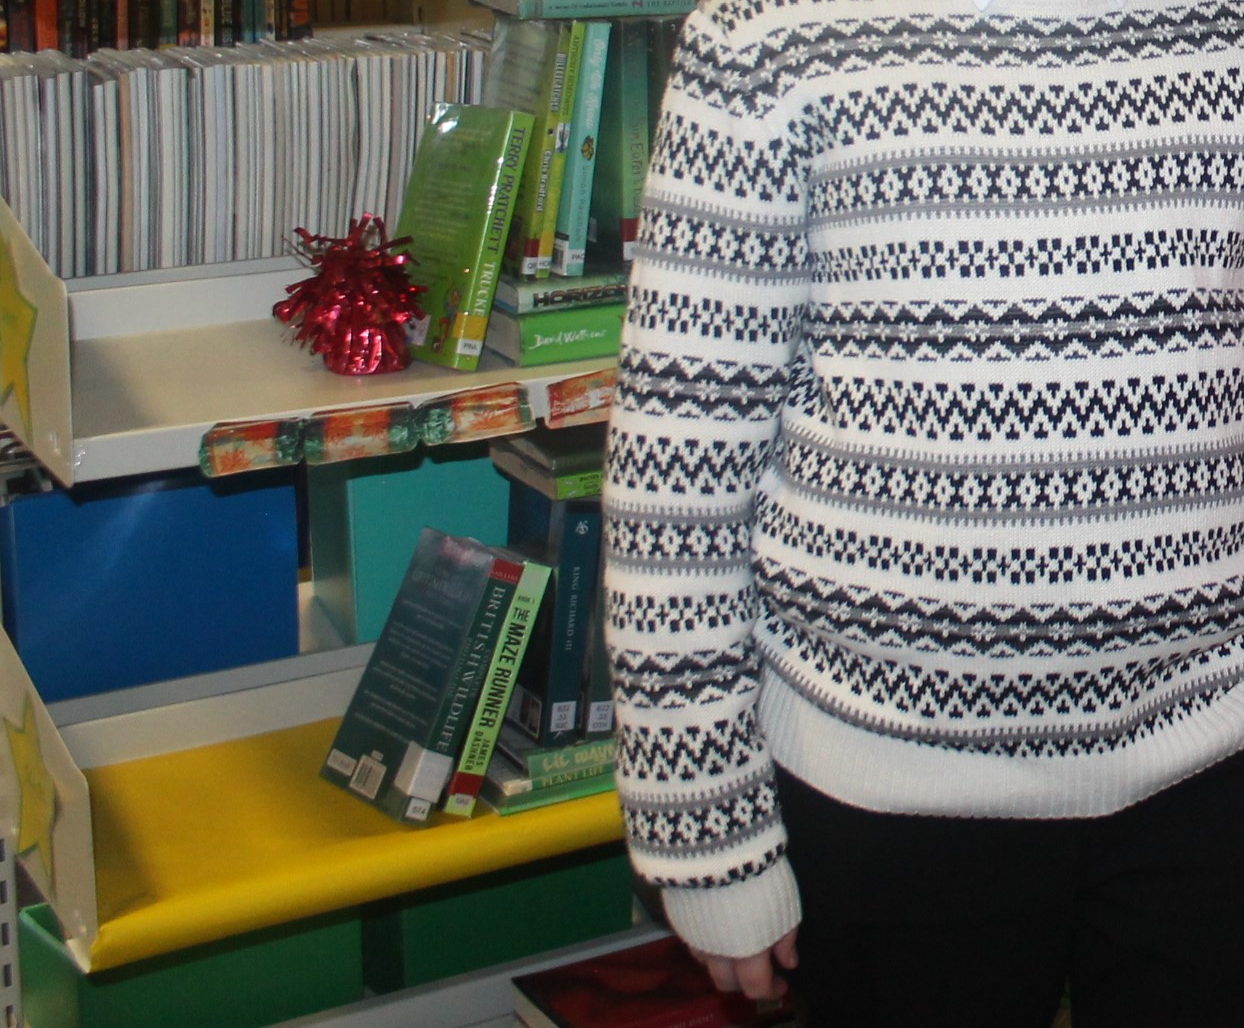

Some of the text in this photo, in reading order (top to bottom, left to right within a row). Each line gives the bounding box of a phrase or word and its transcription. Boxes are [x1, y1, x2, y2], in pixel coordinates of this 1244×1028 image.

[504, 127, 526, 171] TERRY
[543, 150, 552, 170] Chris
[488, 174, 514, 256] PRATCHETT
[474, 261, 496, 317] TRUCKE
[528, 333, 562, 350] David
[571, 566, 580, 591] KING
[566, 594, 577, 637] RICHARD
[435, 584, 507, 753] BRITISH WILDLIFE
[478, 607, 531, 728] THE MAZE RUNNER
[464, 730, 484, 771] DASHNER
[476, 739, 490, 767] JAMES
